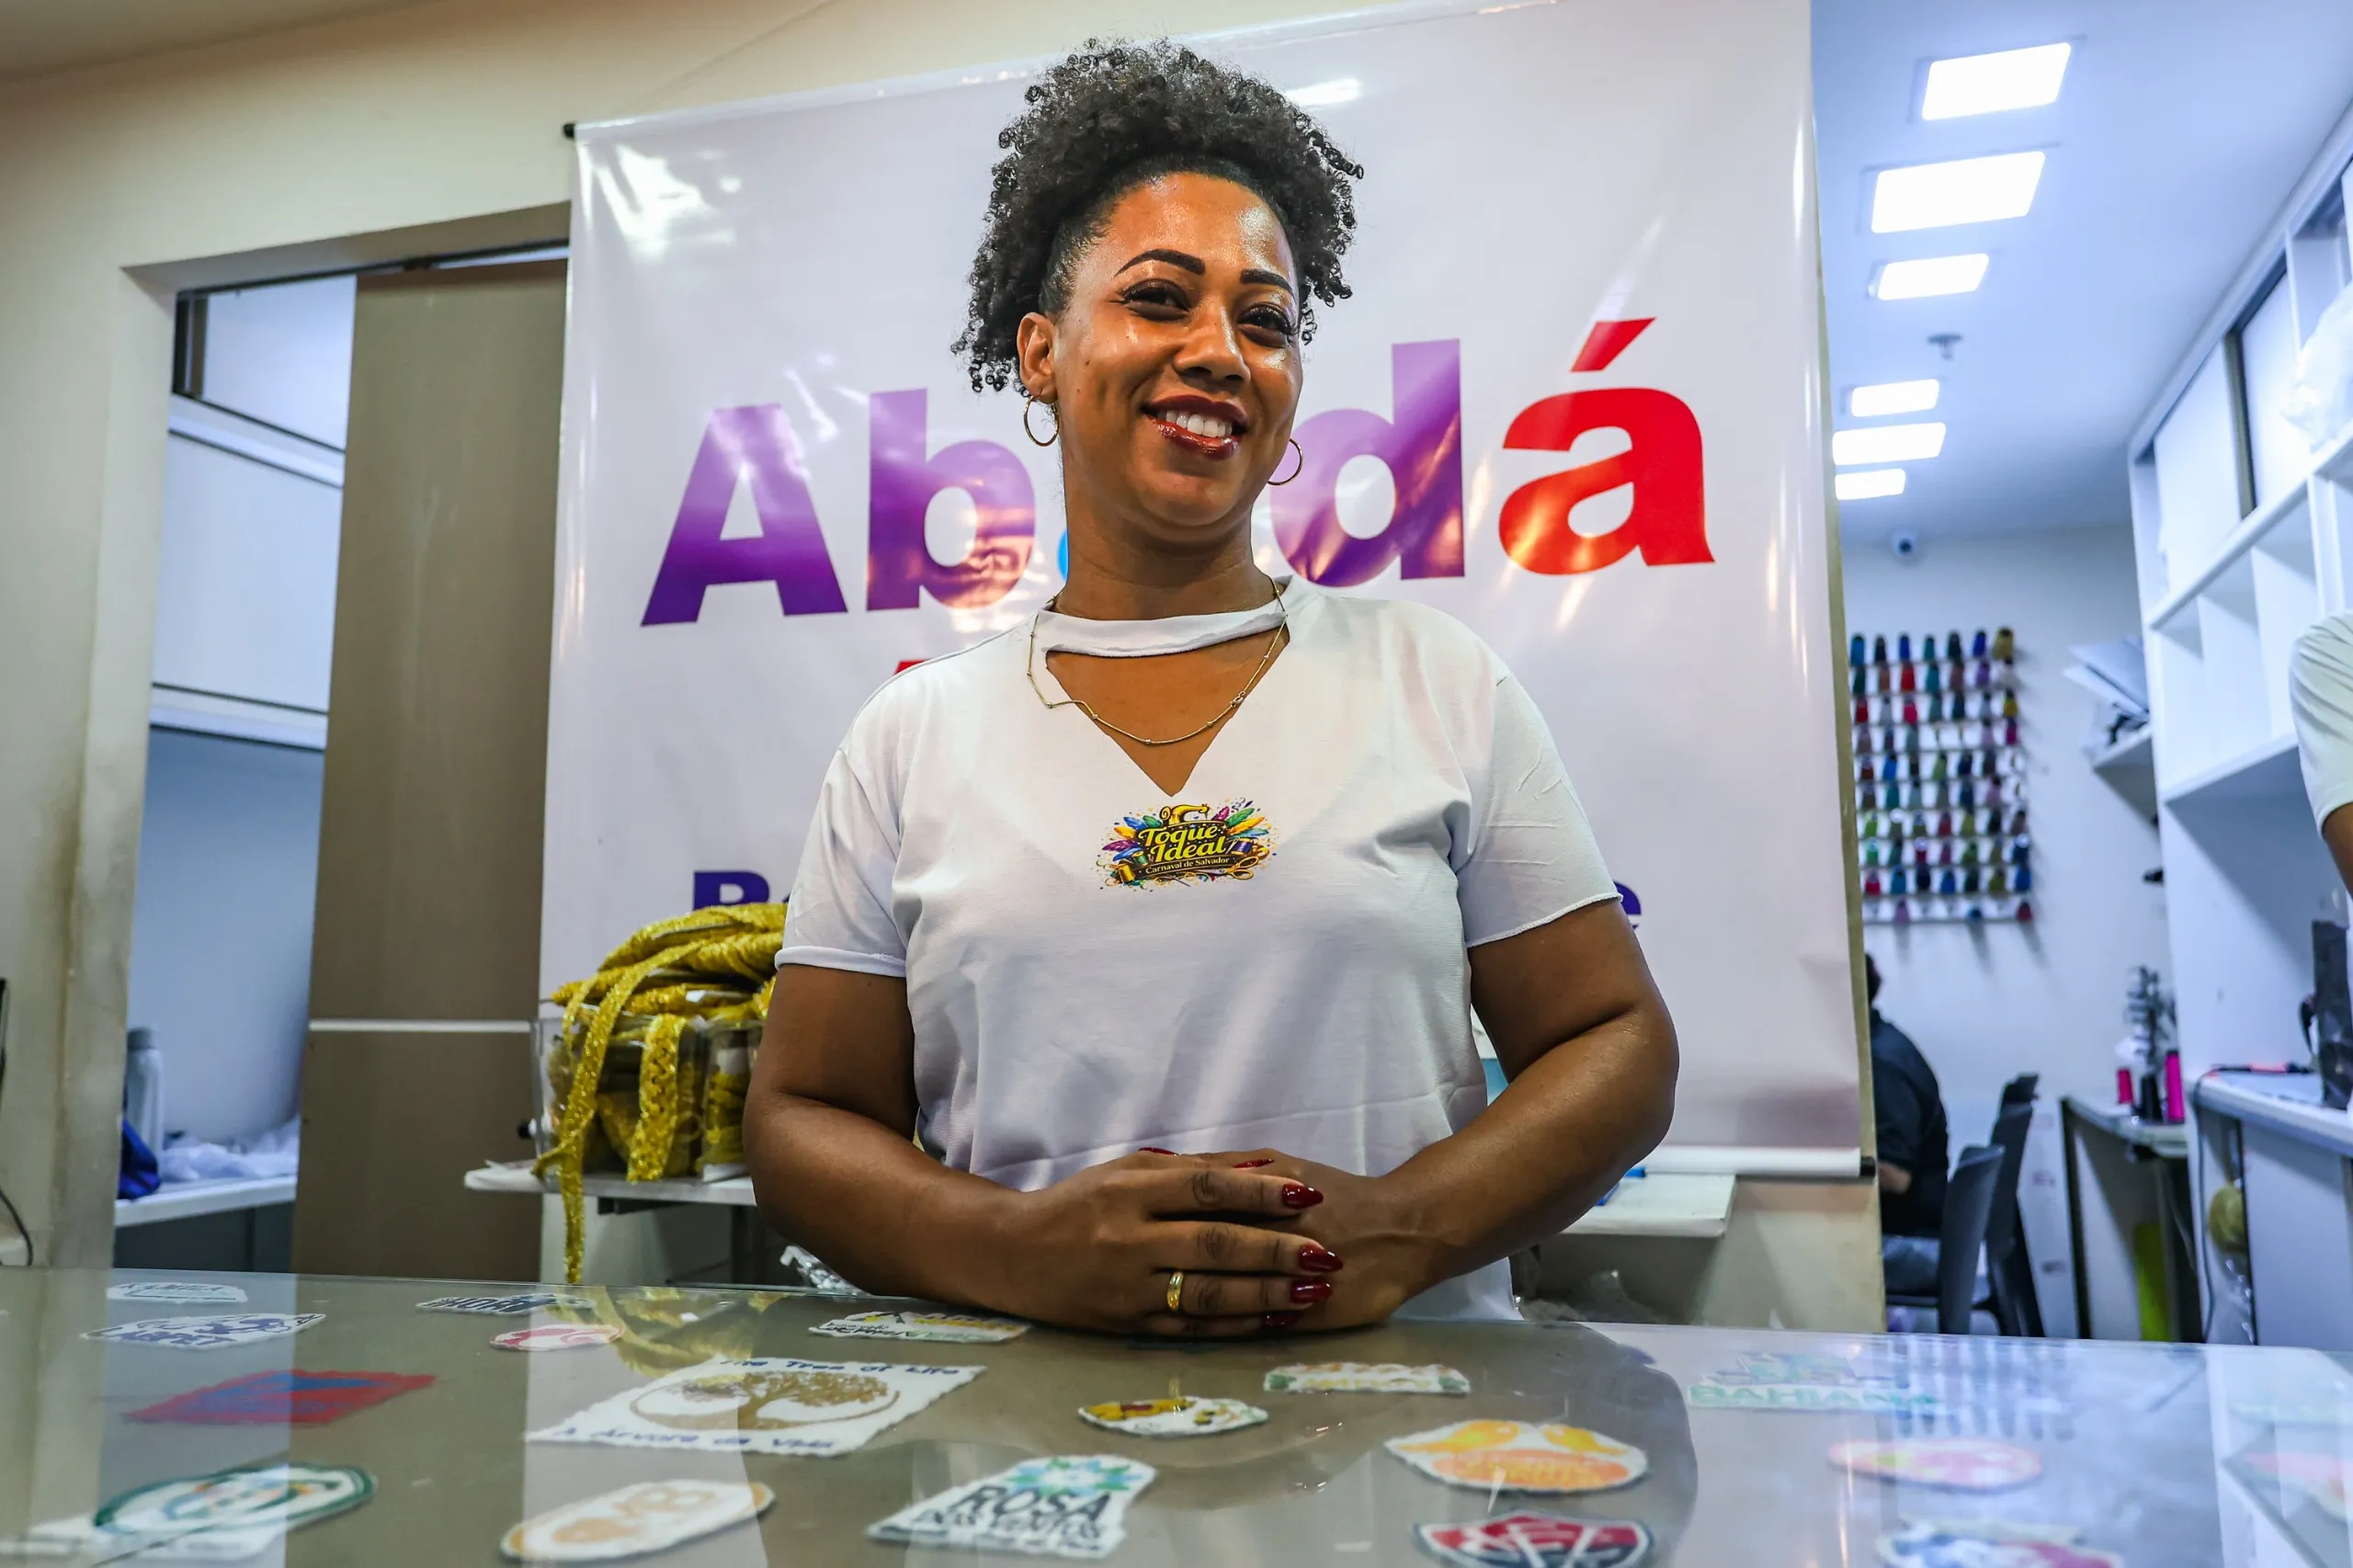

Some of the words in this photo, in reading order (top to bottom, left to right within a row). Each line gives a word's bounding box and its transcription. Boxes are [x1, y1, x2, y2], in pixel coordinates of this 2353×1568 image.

[641, 317, 1715, 627] Abdá
[1138, 825, 1218, 846] Toque
[1150, 836, 1226, 862] Ideal
[1145, 861, 1182, 875] Carnaval
[1195, 856, 1231, 867] Salvador
[786, 1359, 846, 1371] Tree
[859, 1364, 894, 1373] of
[904, 1366, 961, 1376] Life
[947, 1485, 1110, 1521] ROSA
